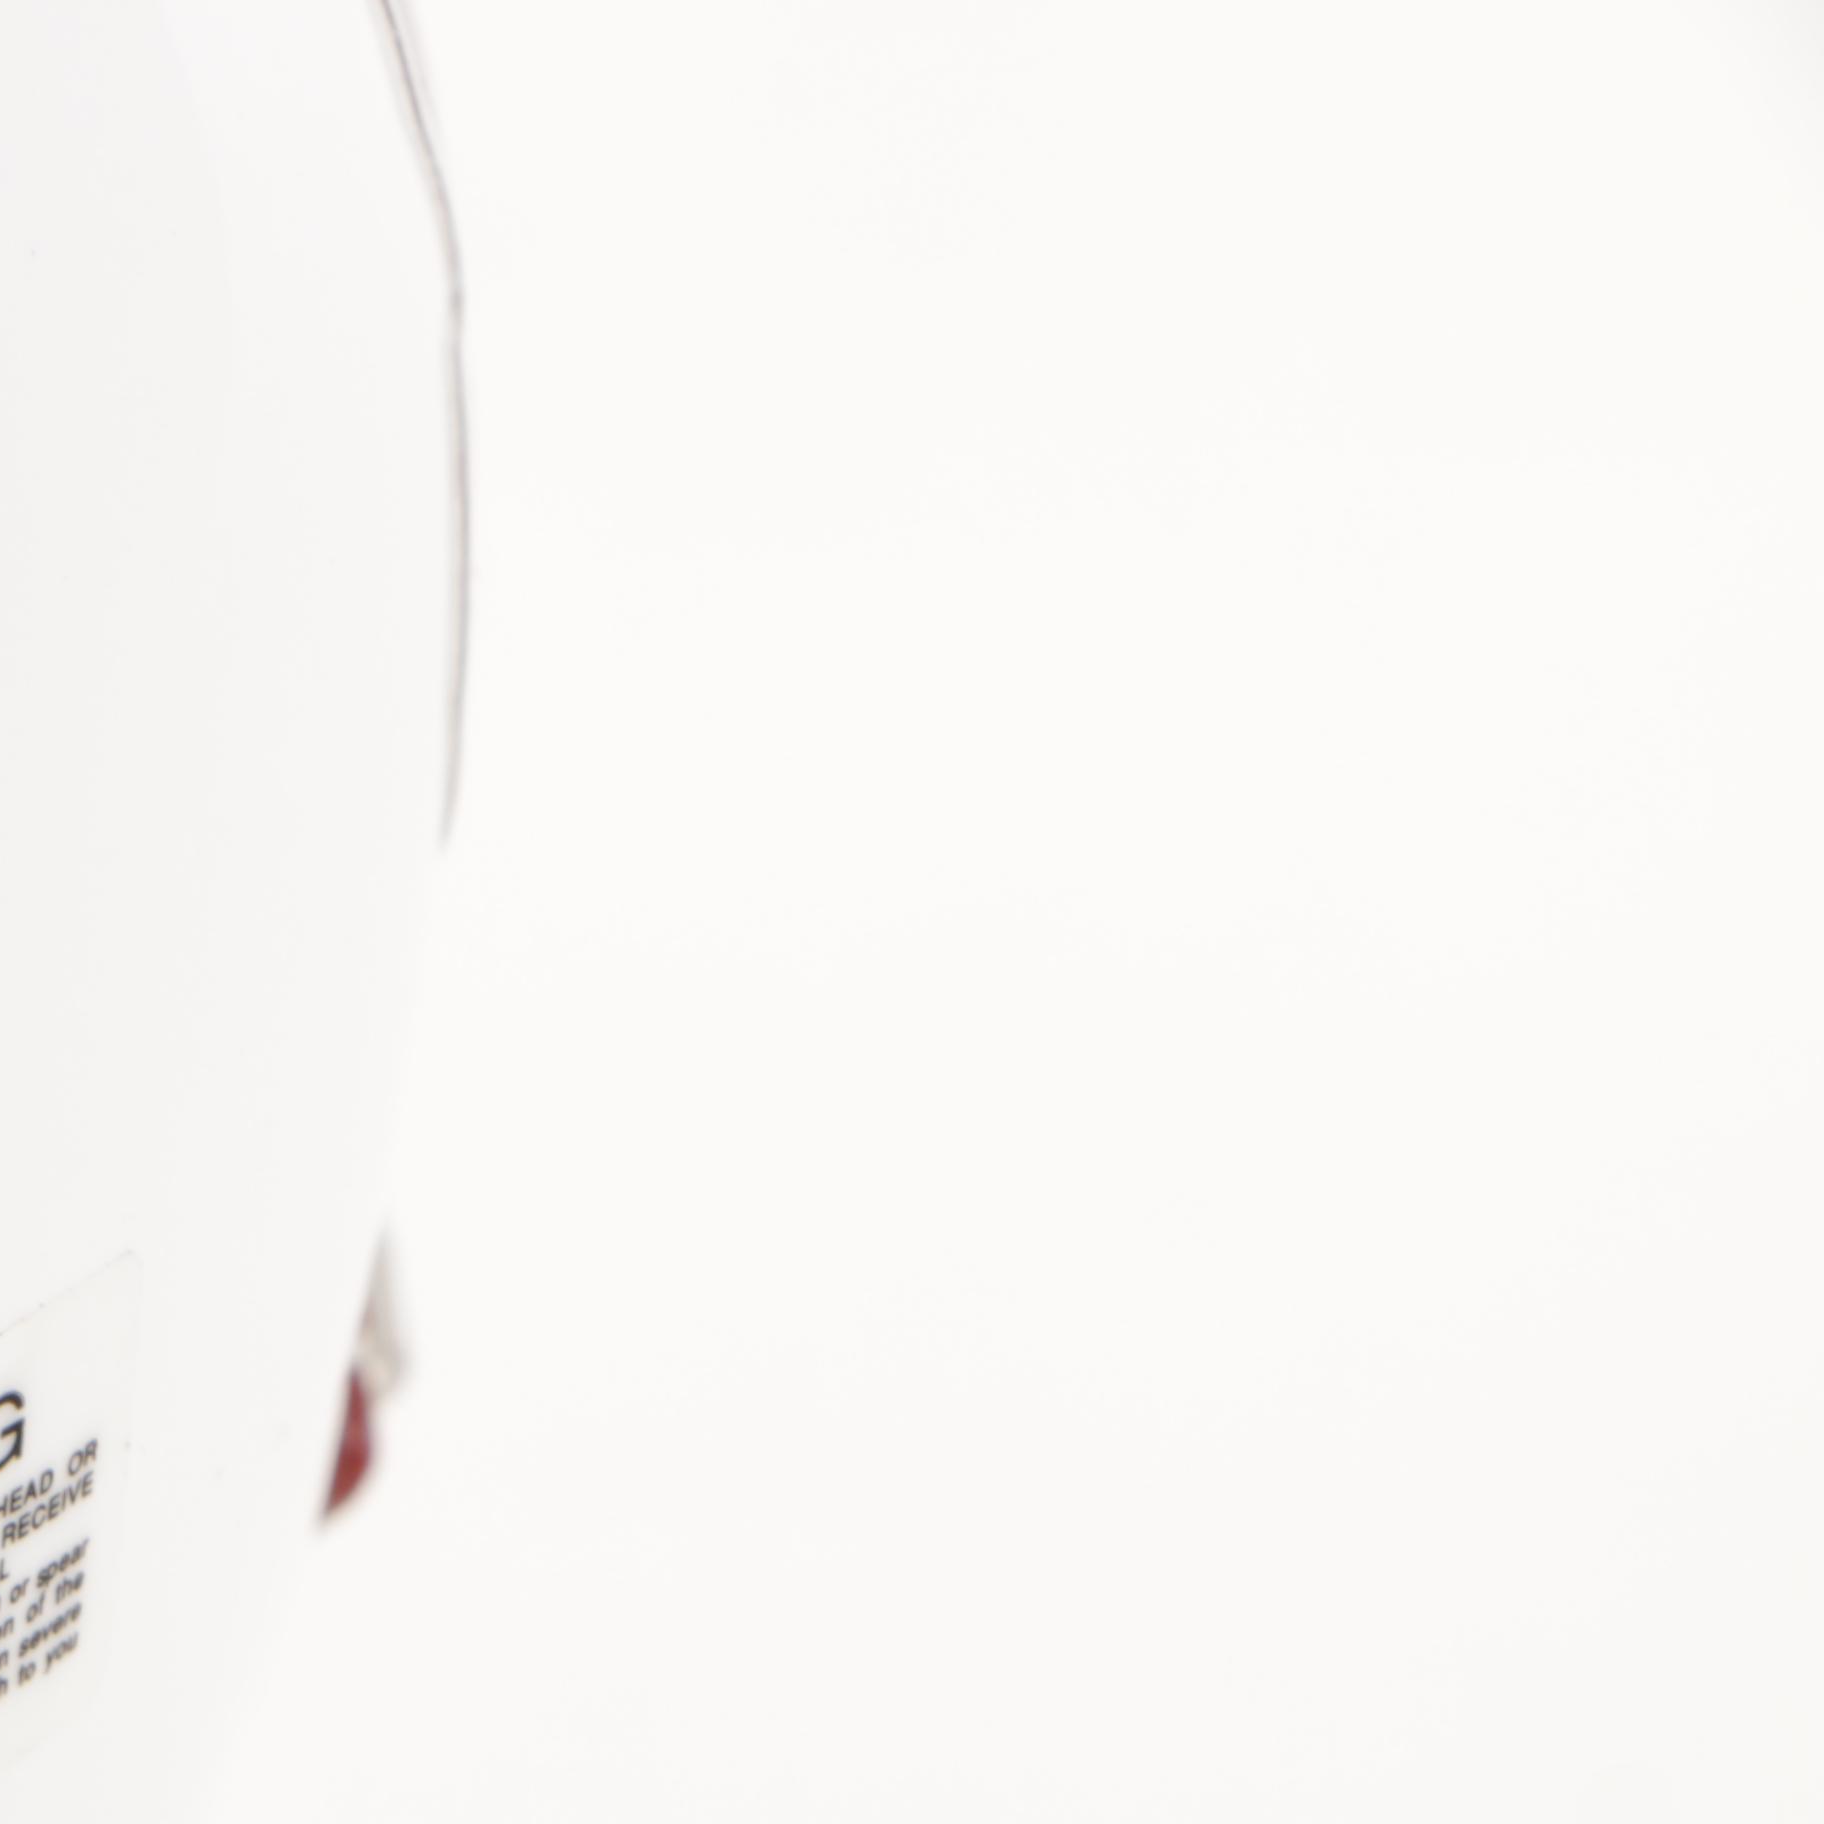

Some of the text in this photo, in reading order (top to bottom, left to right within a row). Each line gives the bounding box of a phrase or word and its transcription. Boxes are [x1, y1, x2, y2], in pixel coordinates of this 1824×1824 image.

[67, 1438, 98, 1477] OR
[1, 1470, 94, 1548] RECEIVE
[9, 1577, 30, 1604] or
[37, 1536, 90, 1588] spear
[25, 1591, 46, 1624] of
[55, 1570, 85, 1600] the
[18, 1602, 82, 1658] severe
[18, 1660, 37, 1686] to
